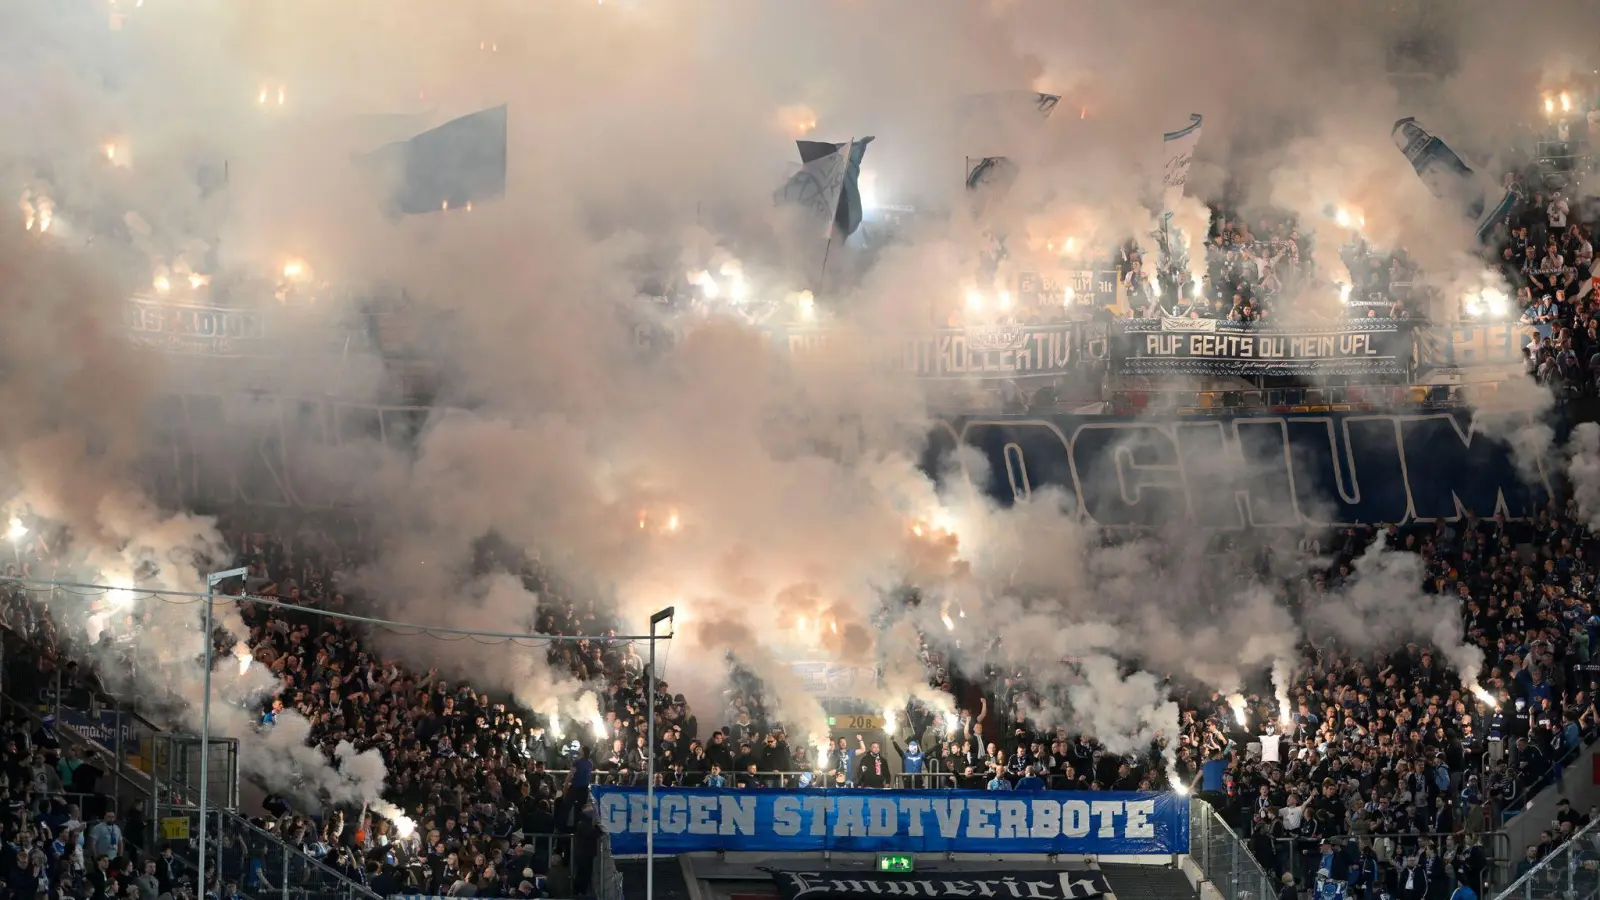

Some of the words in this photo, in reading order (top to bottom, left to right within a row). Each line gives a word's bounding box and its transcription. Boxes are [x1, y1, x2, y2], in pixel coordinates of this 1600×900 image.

[1147, 334, 1184, 355] AUF
[1189, 335, 1254, 357] GEHTS
[1258, 337, 1284, 358] DU
[1290, 335, 1335, 357] MEIN
[1339, 333, 1376, 356] VFL
[925, 412, 1550, 525] OCHUM
[601, 793, 756, 838] GEGEN
[772, 796, 1156, 841] STADTVERBOTE
[779, 870, 1103, 900] Emmerich
